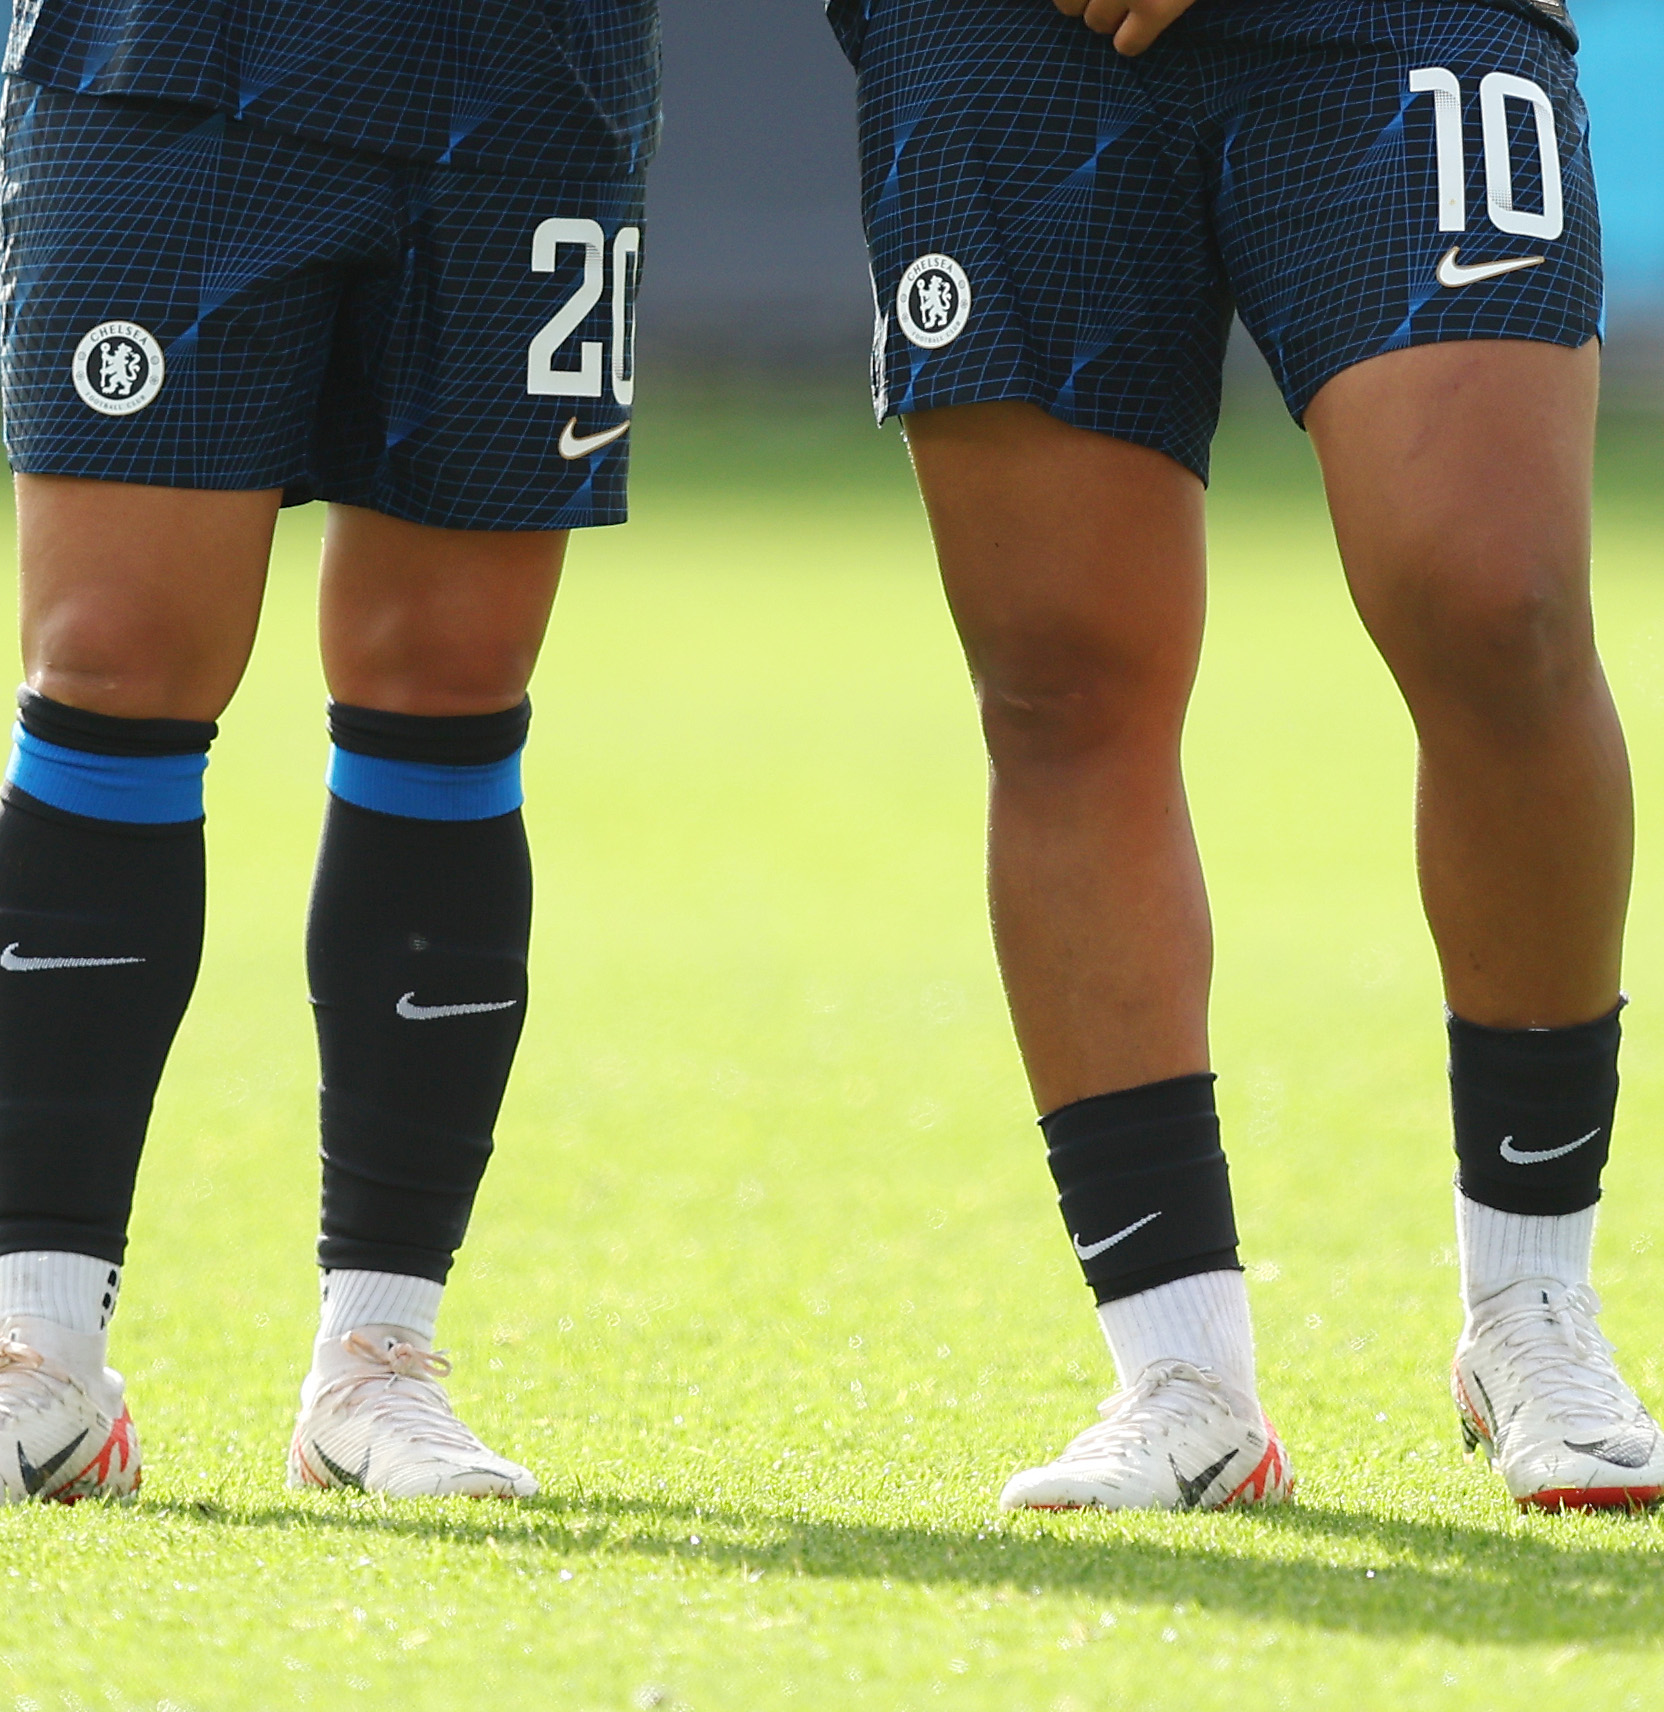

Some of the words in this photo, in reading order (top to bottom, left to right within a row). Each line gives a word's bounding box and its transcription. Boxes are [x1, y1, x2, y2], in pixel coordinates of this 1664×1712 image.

[1409, 67, 1564, 240] 10
[527, 217, 640, 406] 20
[907, 257, 953, 281] CHELSEA
[90, 324, 149, 346] CHELSEA
